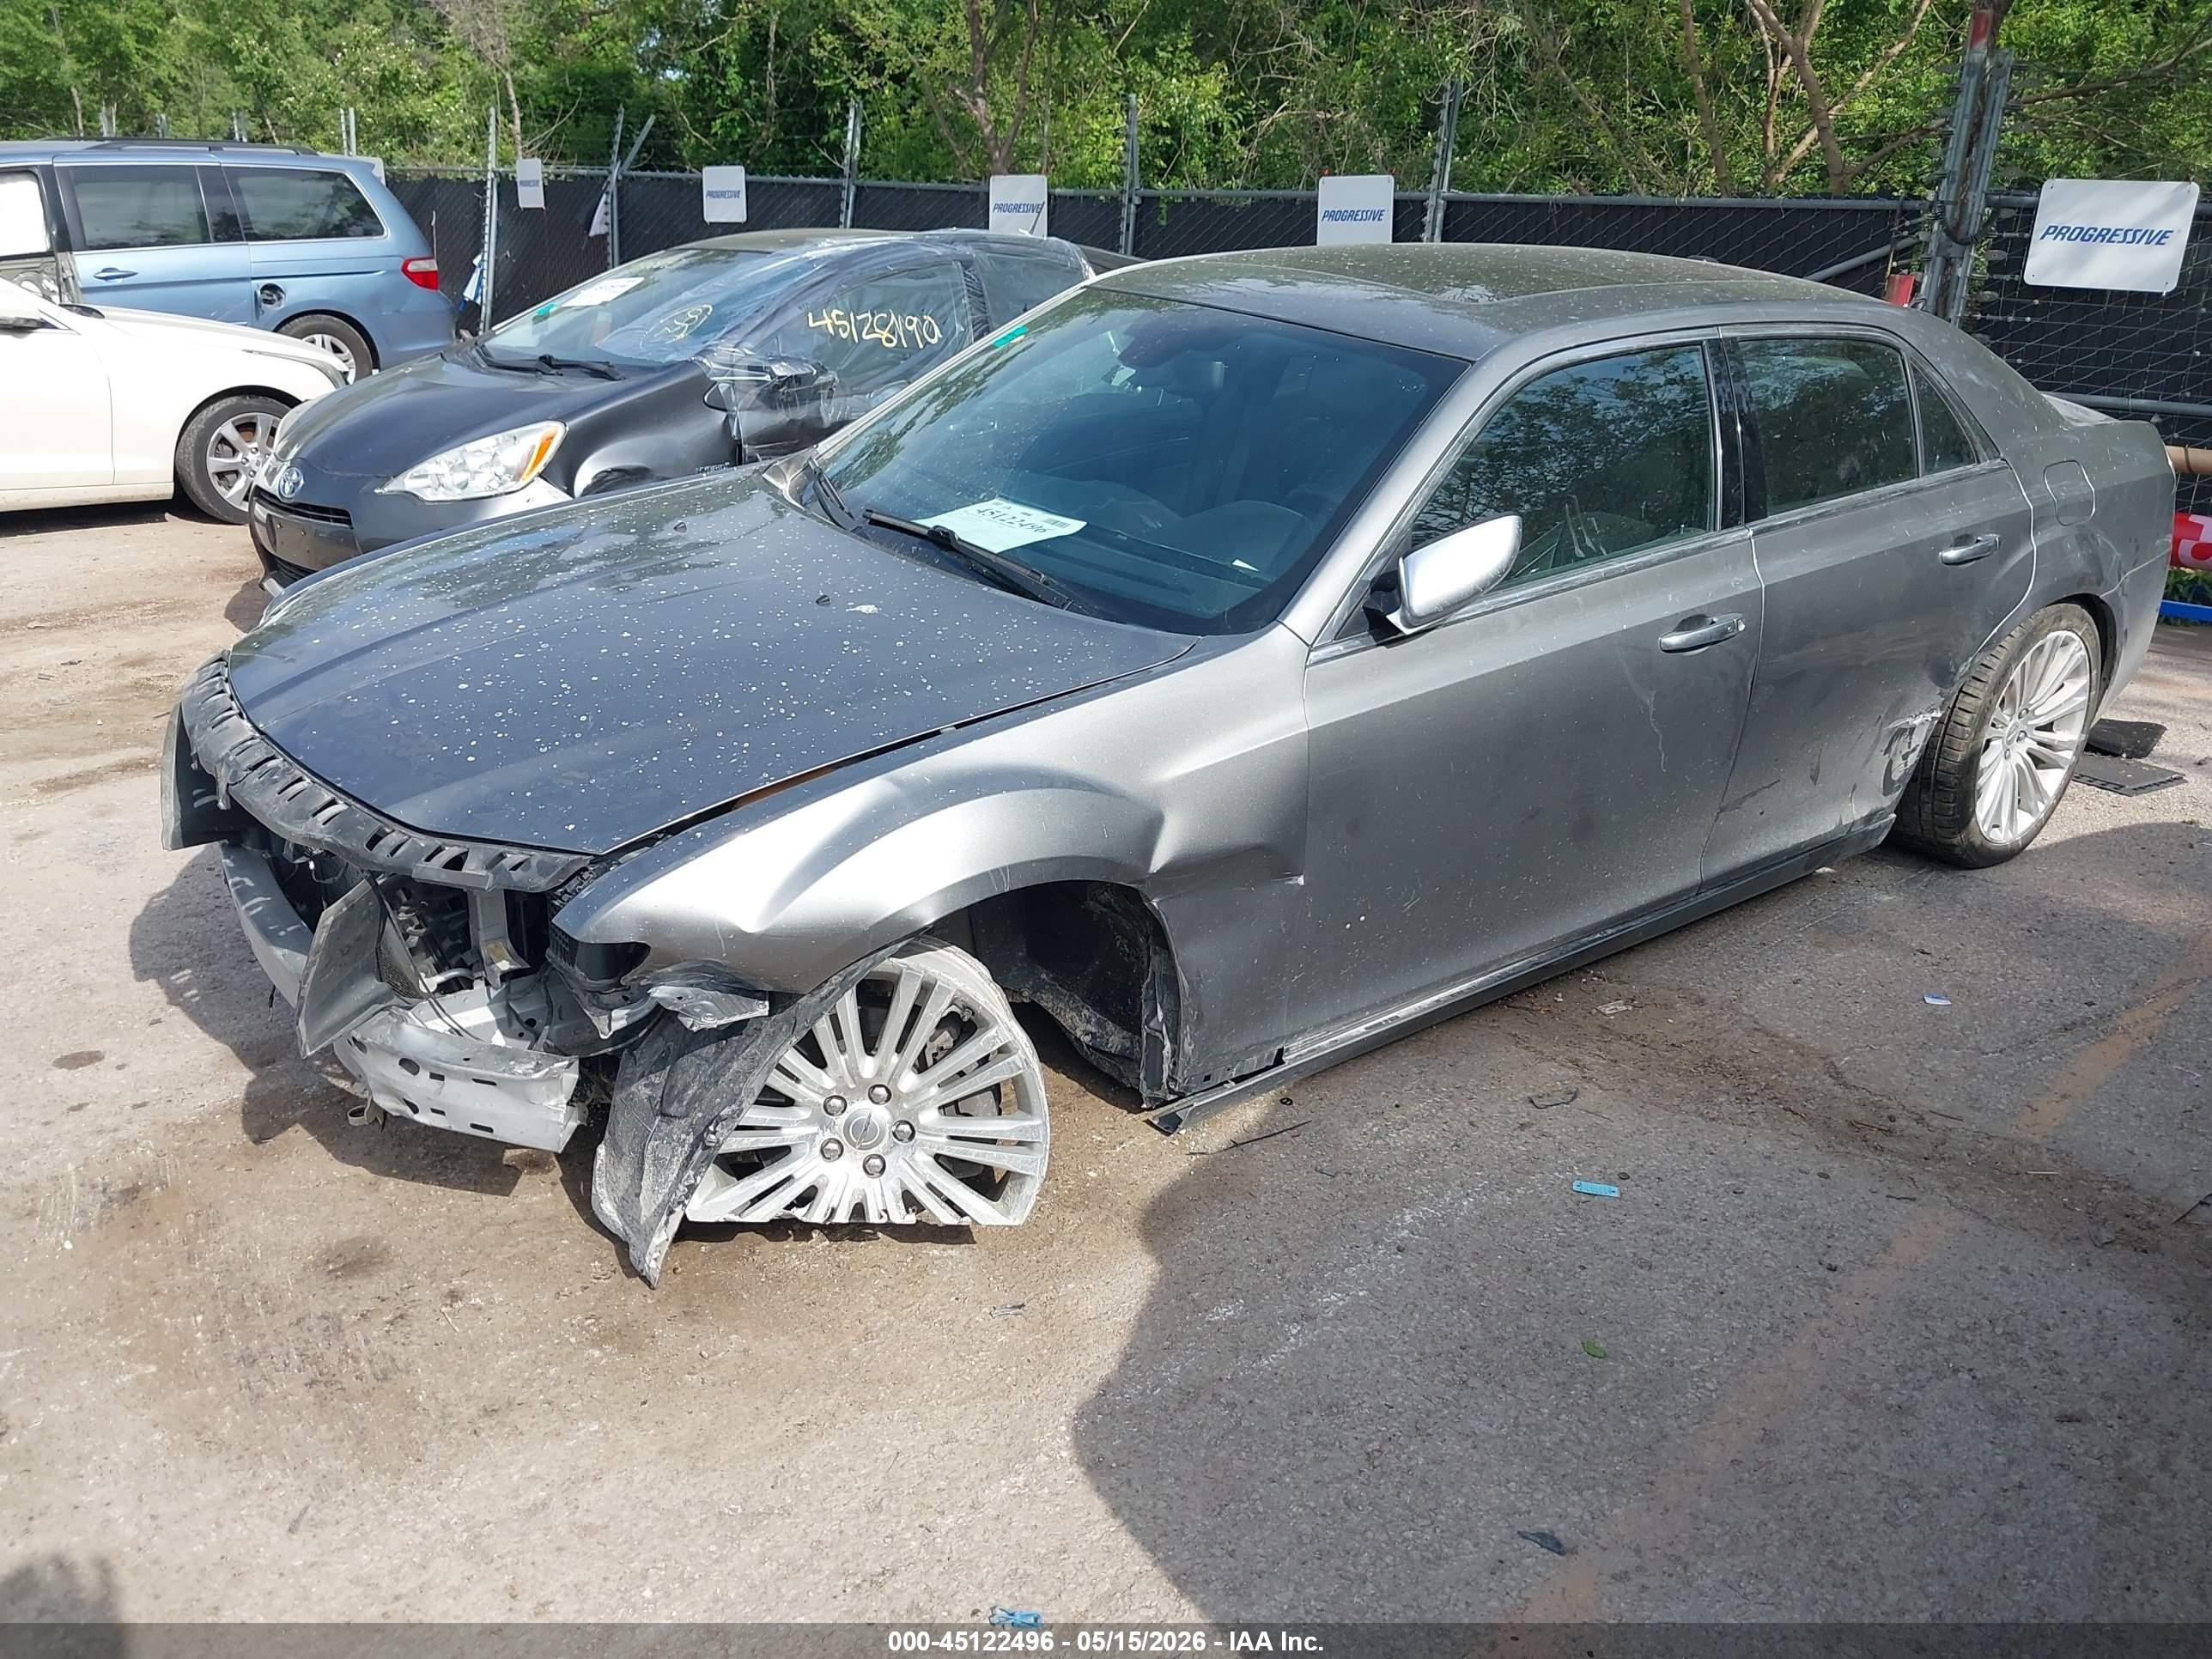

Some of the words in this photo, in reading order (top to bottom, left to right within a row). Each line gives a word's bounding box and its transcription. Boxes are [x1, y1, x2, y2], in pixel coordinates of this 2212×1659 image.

[993, 203, 1042, 214] PROGRESSIVE
[1321, 209, 1386, 222] PROGRESSIVE
[2039, 224, 2174, 246] PROGRESSIVE
